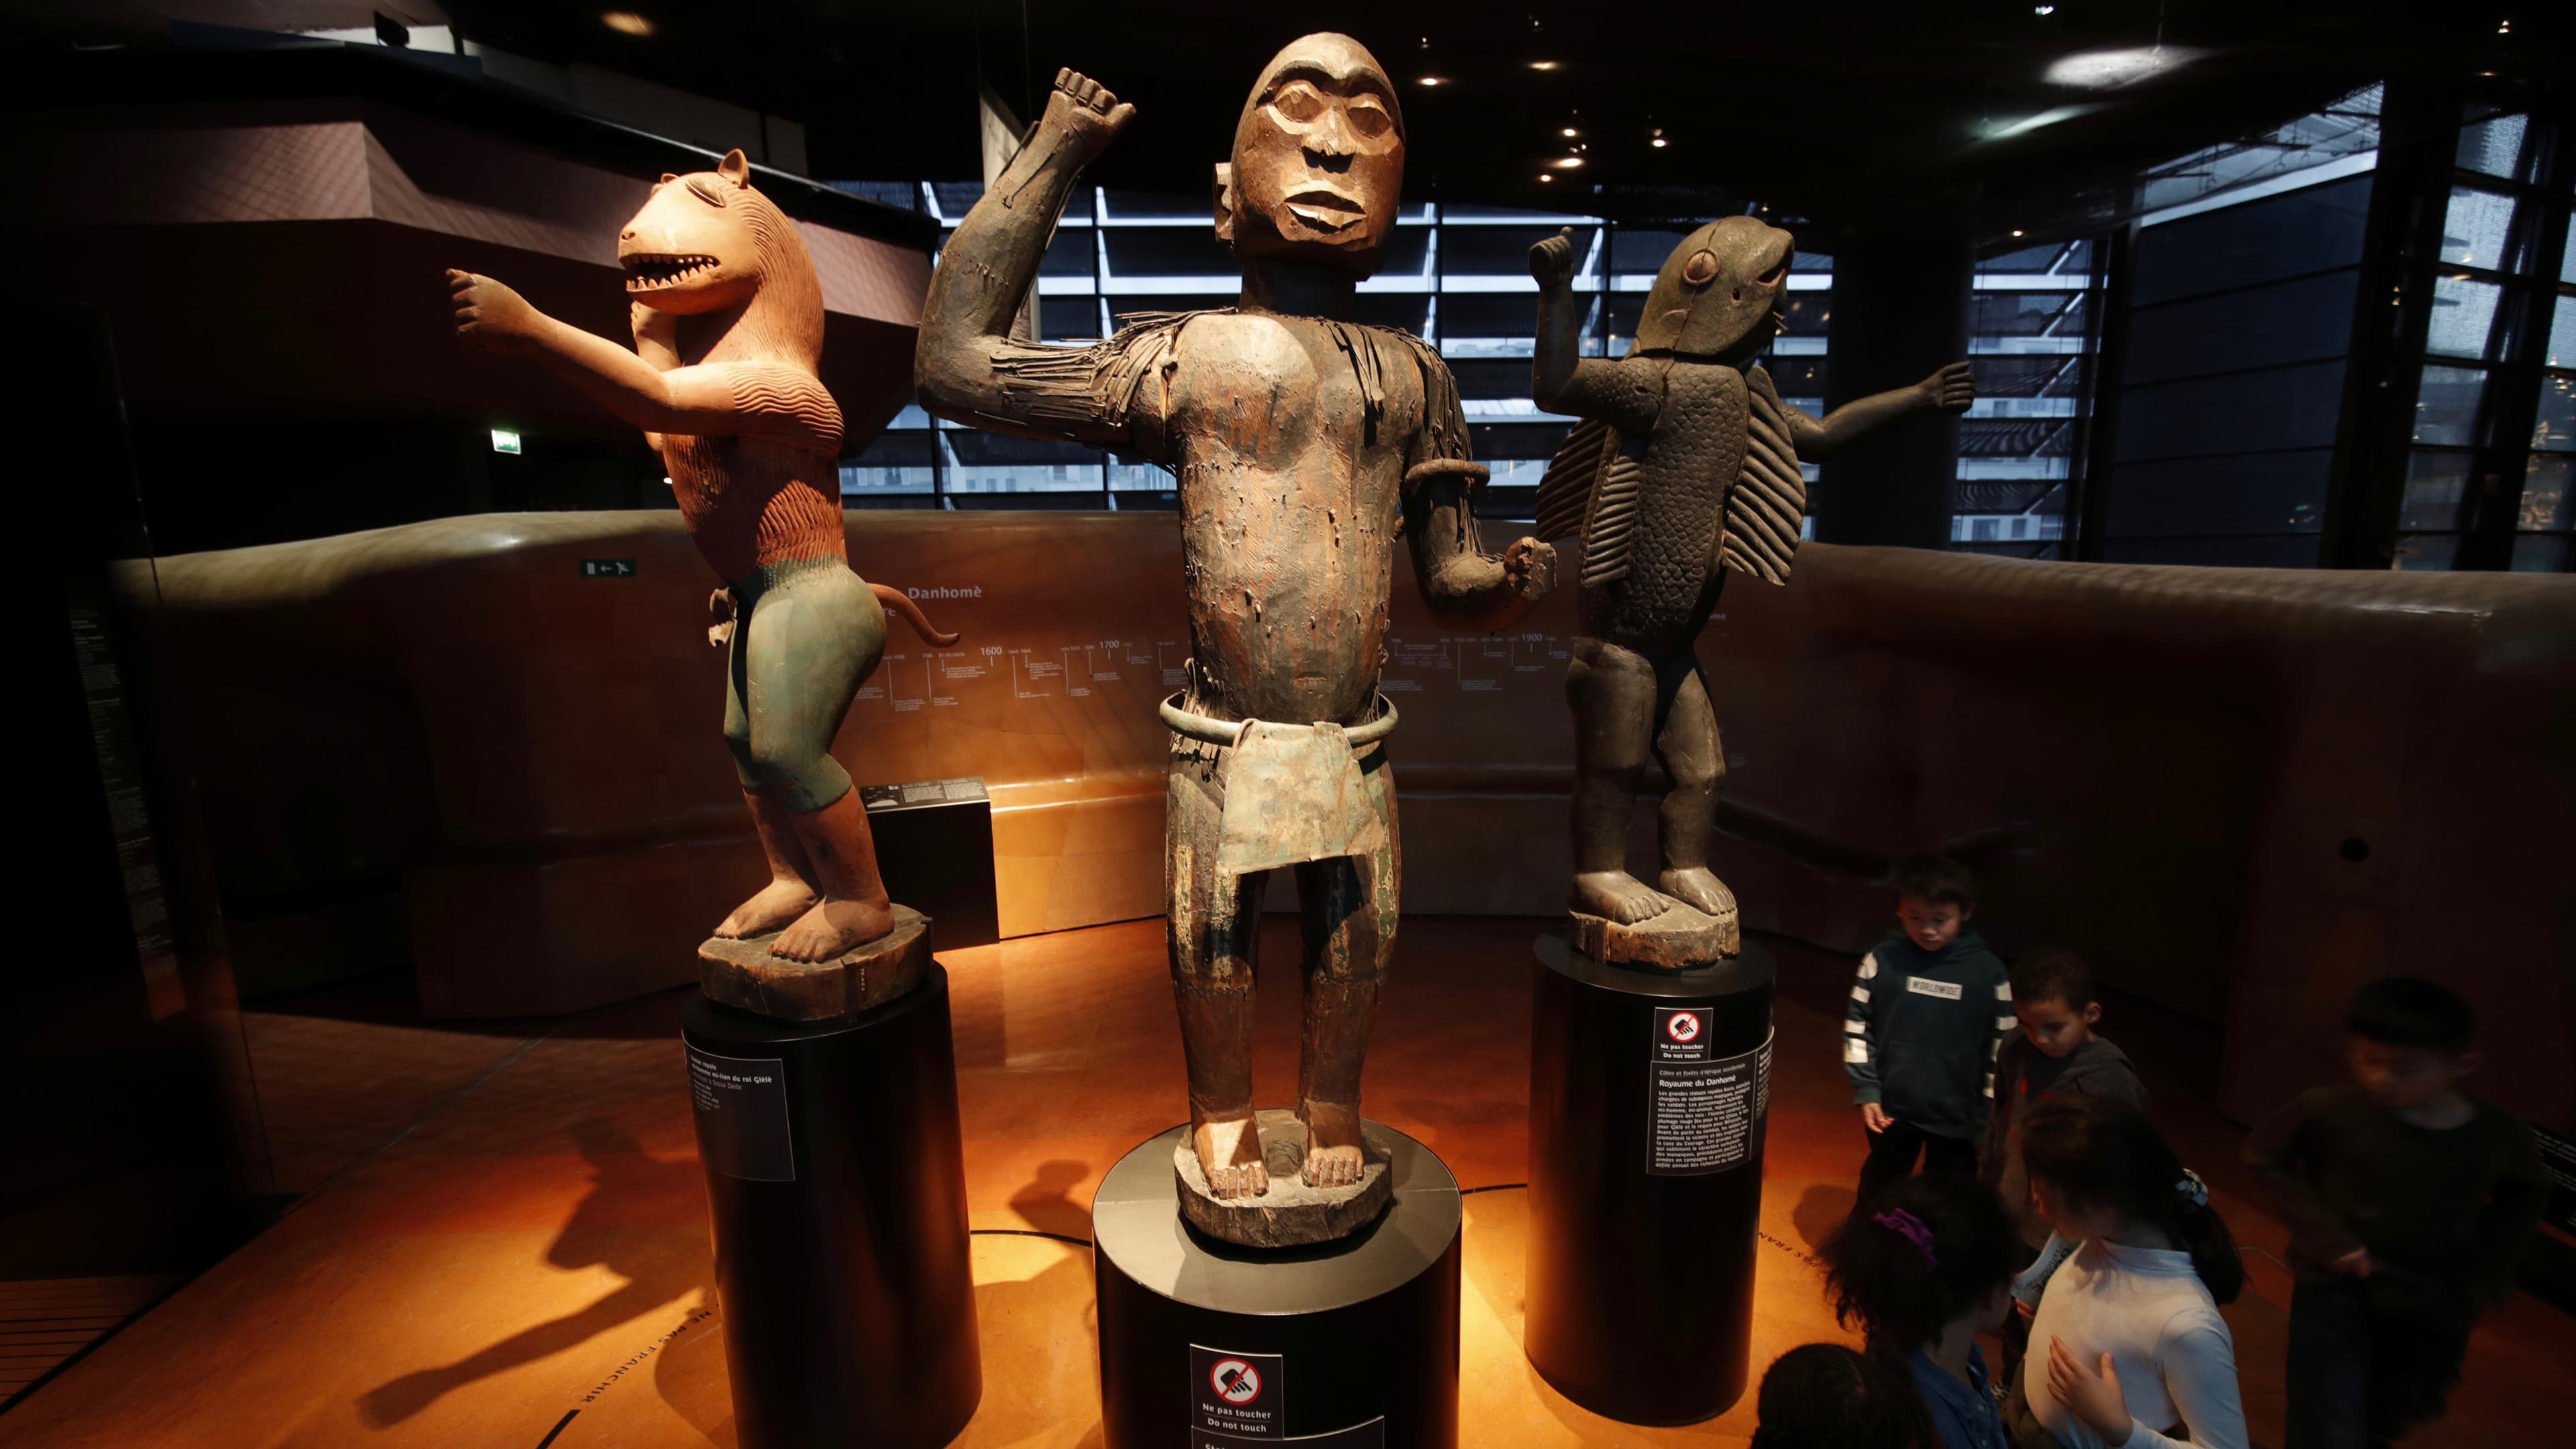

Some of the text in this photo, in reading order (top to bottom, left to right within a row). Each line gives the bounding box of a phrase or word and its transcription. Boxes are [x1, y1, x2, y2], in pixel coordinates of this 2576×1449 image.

[908, 586, 982, 599] Danhomè
[981, 647, 1002, 655] 1600
[1099, 641, 1119, 649] 1700
[1914, 981, 1959, 996] WORLDWIDE
[712, 1072, 731, 1081] mi-lion
[754, 1076, 772, 1084] Glèlè
[1700, 1068, 1721, 1076] d'Afrique
[1659, 1079, 1693, 1088] Royaume
[1707, 1075, 1736, 1085] Danhomè
[1699, 1099, 1726, 1108] personnages
[1697, 1148, 1723, 1157] précédaient
[1683, 1156, 1707, 1164] campagne
[581, 1311, 712, 1403] NE PAS FRANCHIR
[1203, 1403, 1272, 1419] Ne pas toucher
[1208, 1417, 1267, 1432] Do not touch
